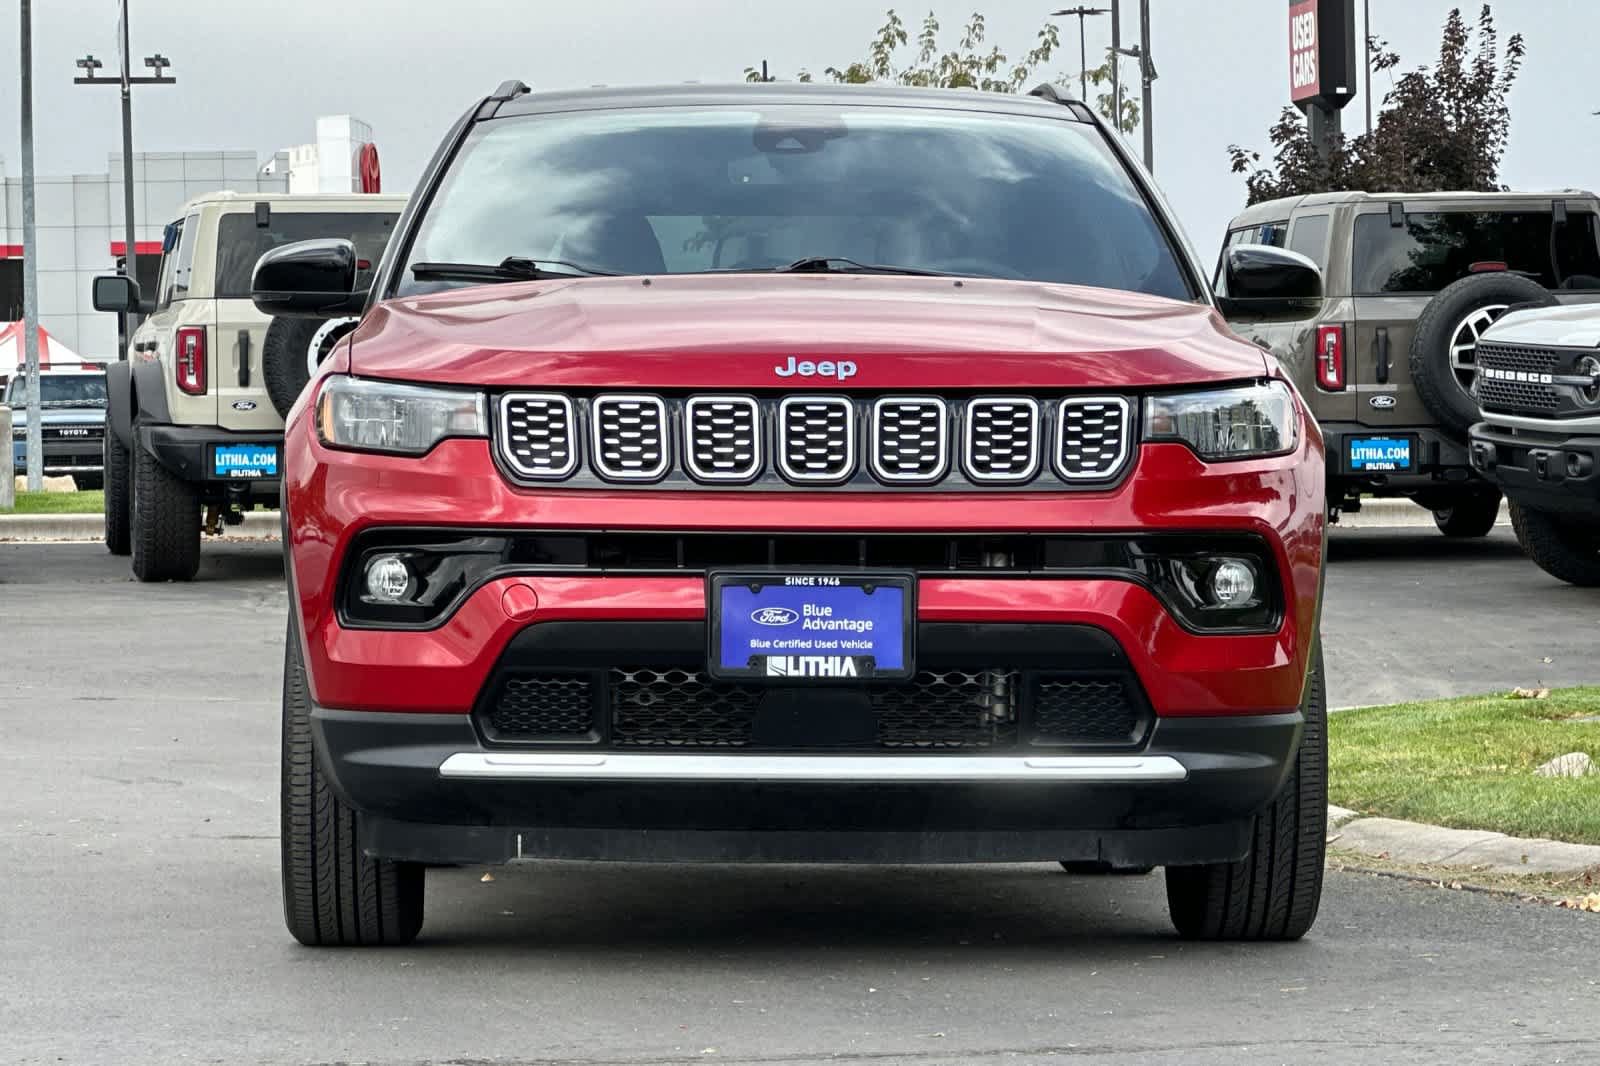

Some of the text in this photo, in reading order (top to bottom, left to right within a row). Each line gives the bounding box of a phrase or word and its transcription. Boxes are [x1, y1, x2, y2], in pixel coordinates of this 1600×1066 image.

[1292, 11, 1315, 51] USED
[1293, 49, 1316, 88] CARS
[775, 356, 857, 380] Jeep
[1485, 368, 1552, 384] BRONCO
[215, 453, 276, 466] LITHIA.COM
[1351, 447, 1410, 460] LITHIA.COM
[1373, 462, 1396, 470] LITHIA
[238, 469, 261, 477] LITHIA
[785, 577, 840, 586] SINCE 1946
[803, 604, 832, 617] Blue
[802, 618, 873, 633] Advantage
[750, 639, 873, 649] Blue Certified Used Vehicle
[787, 656, 857, 677] LITHIA
